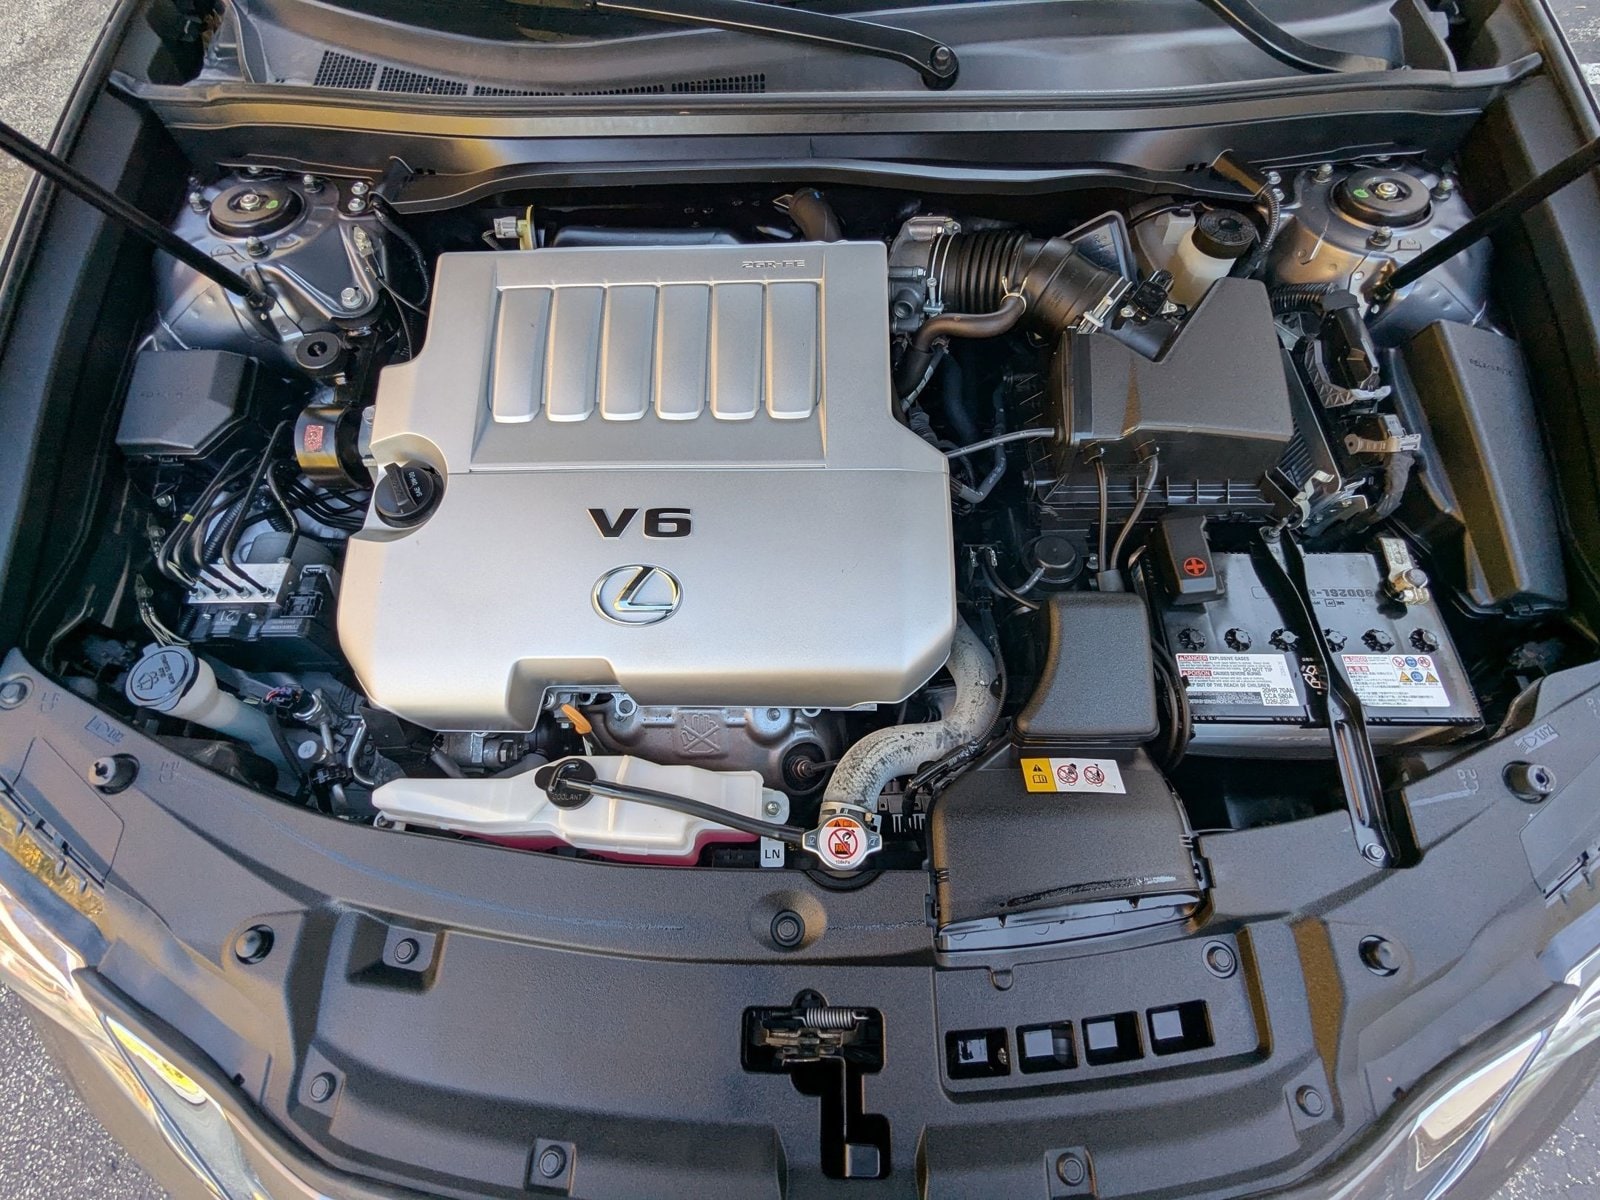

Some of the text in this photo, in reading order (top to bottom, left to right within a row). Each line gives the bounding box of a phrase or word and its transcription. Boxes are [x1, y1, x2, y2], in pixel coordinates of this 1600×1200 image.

[586, 508, 692, 539] V6
[552, 793, 583, 801] COOLANT
[764, 849, 780, 859] LN
